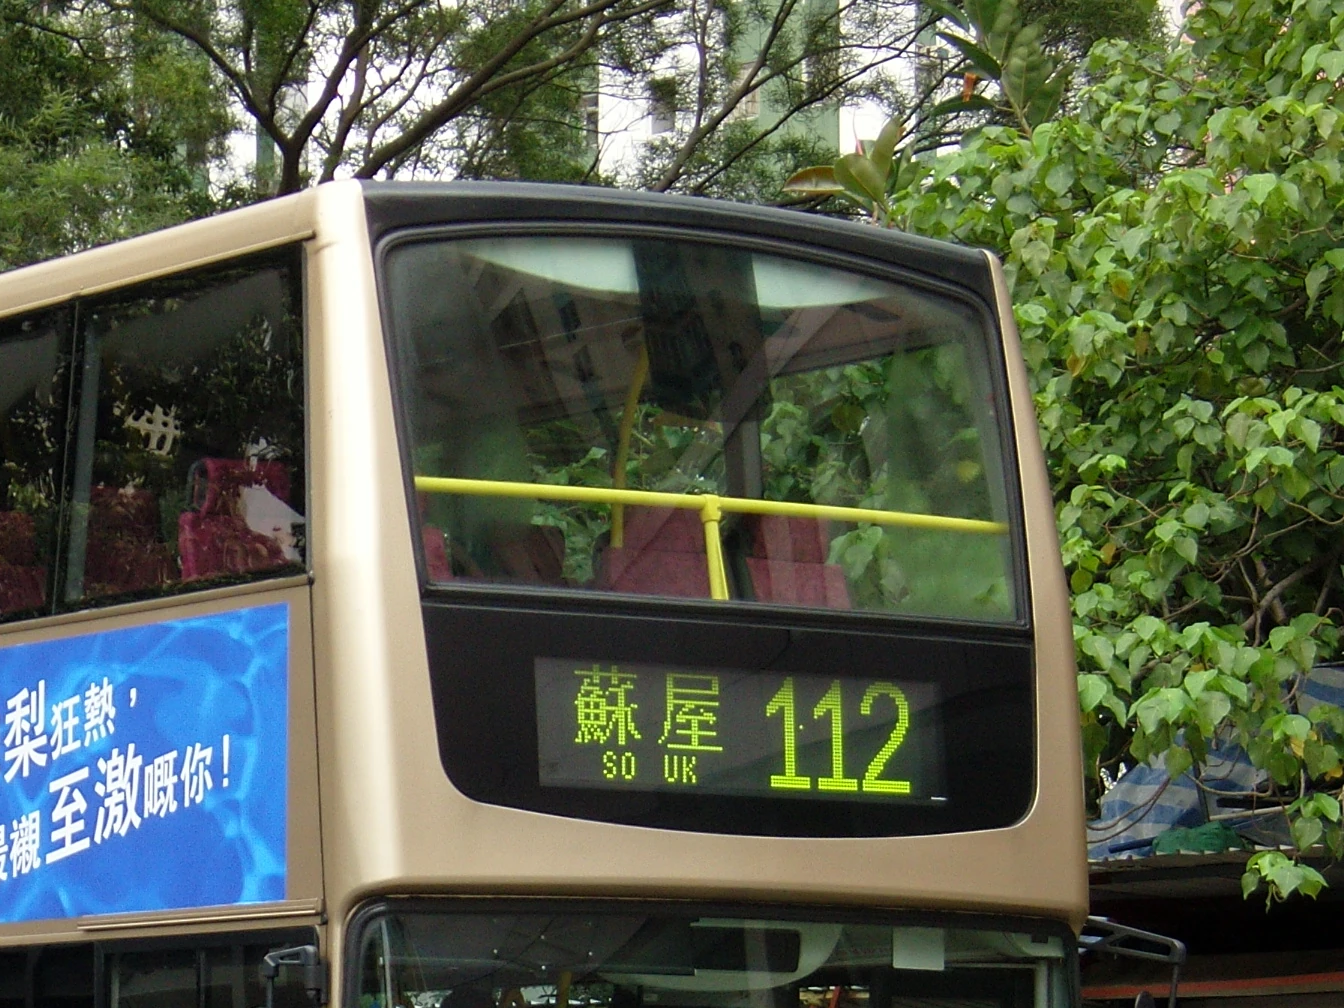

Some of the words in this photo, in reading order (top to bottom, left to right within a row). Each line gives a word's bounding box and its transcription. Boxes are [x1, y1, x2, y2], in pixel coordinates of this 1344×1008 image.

[573, 664, 724, 752] 蘇屋
[765, 676, 911, 793] 112
[602, 751, 636, 780] SO
[663, 754, 697, 784] UK
